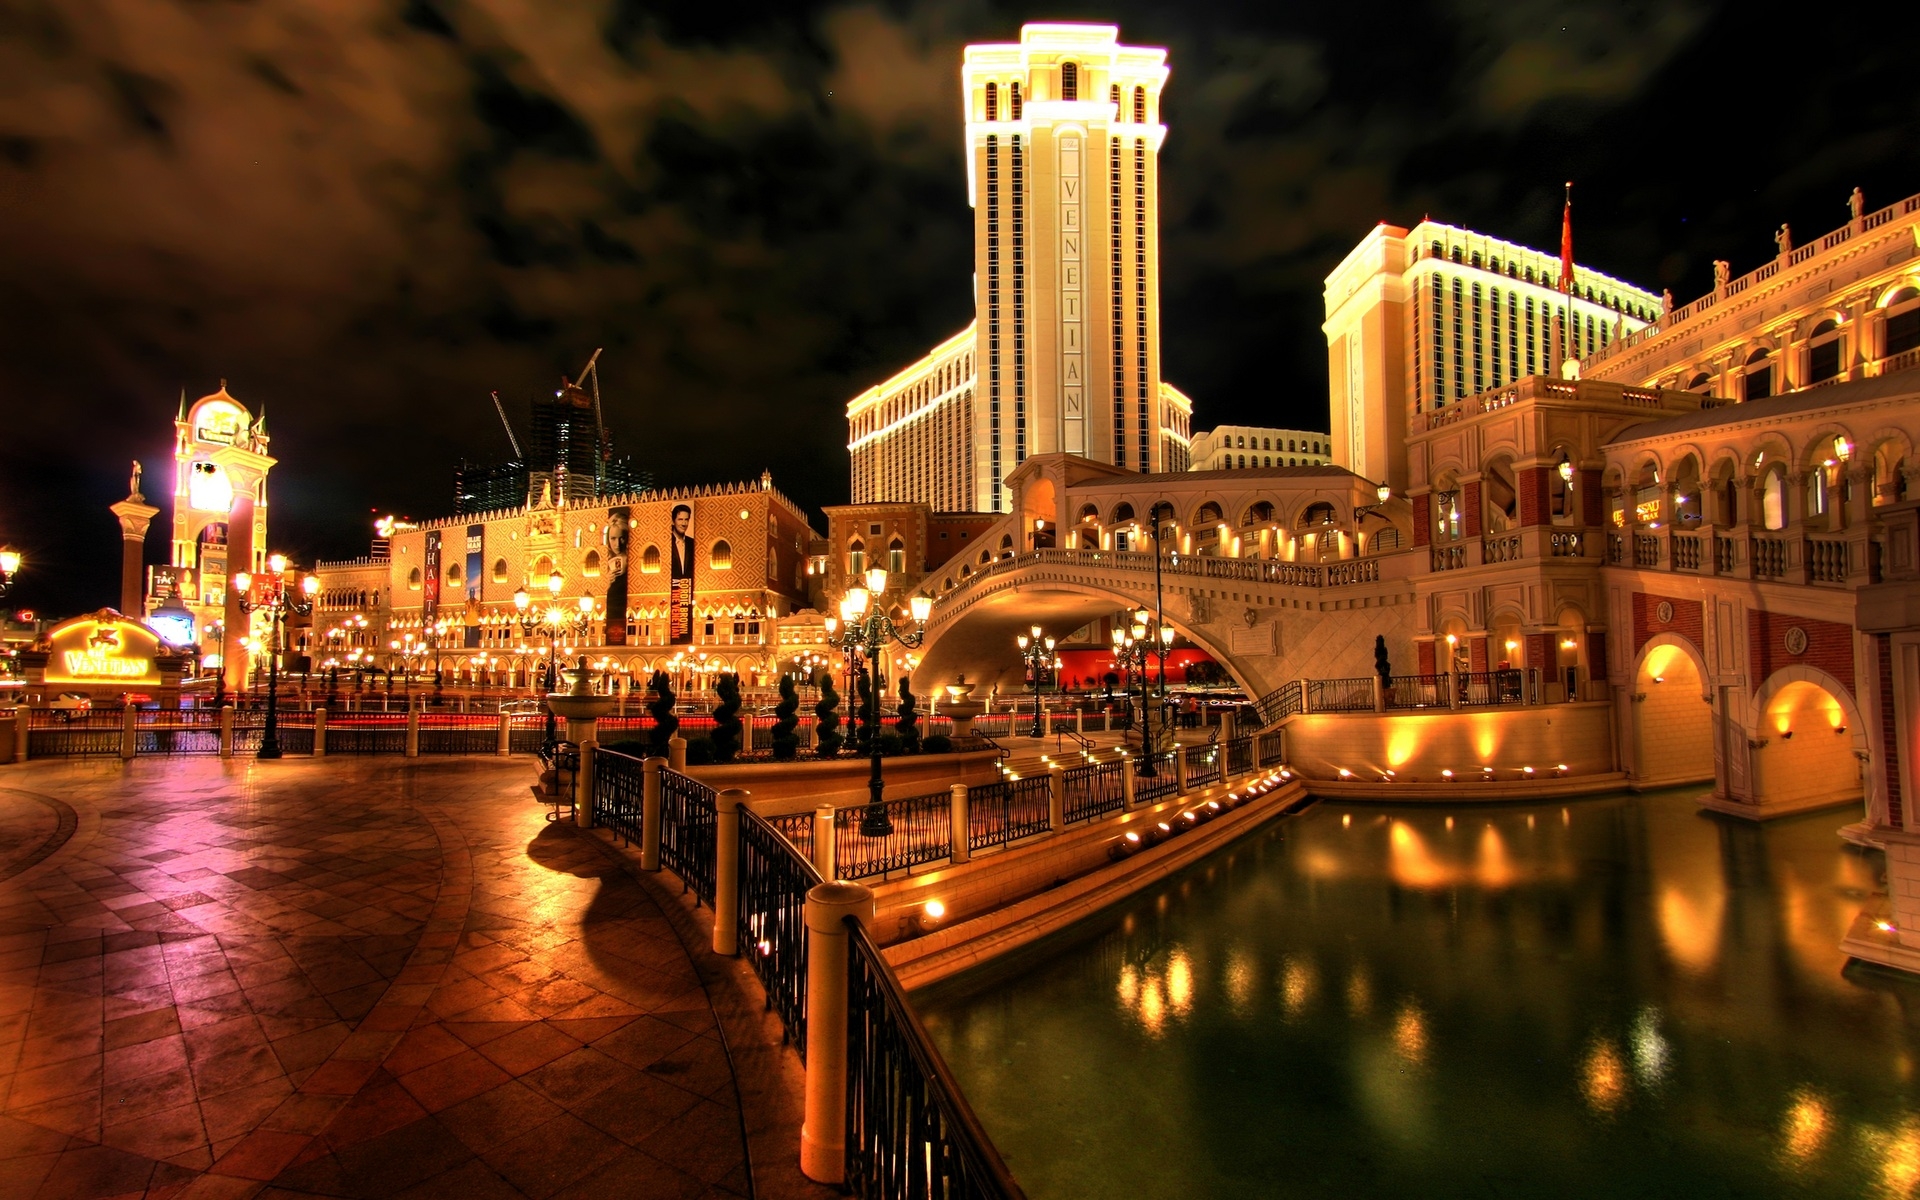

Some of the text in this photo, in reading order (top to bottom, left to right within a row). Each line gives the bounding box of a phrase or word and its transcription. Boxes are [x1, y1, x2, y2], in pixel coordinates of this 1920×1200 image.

[1065, 180, 1080, 411] VENETIAN
[672, 579, 680, 638] AT THE VENETIAN
[680, 578, 688, 634] GORDIE BROWN
[65, 651, 148, 675] VENETIAN
